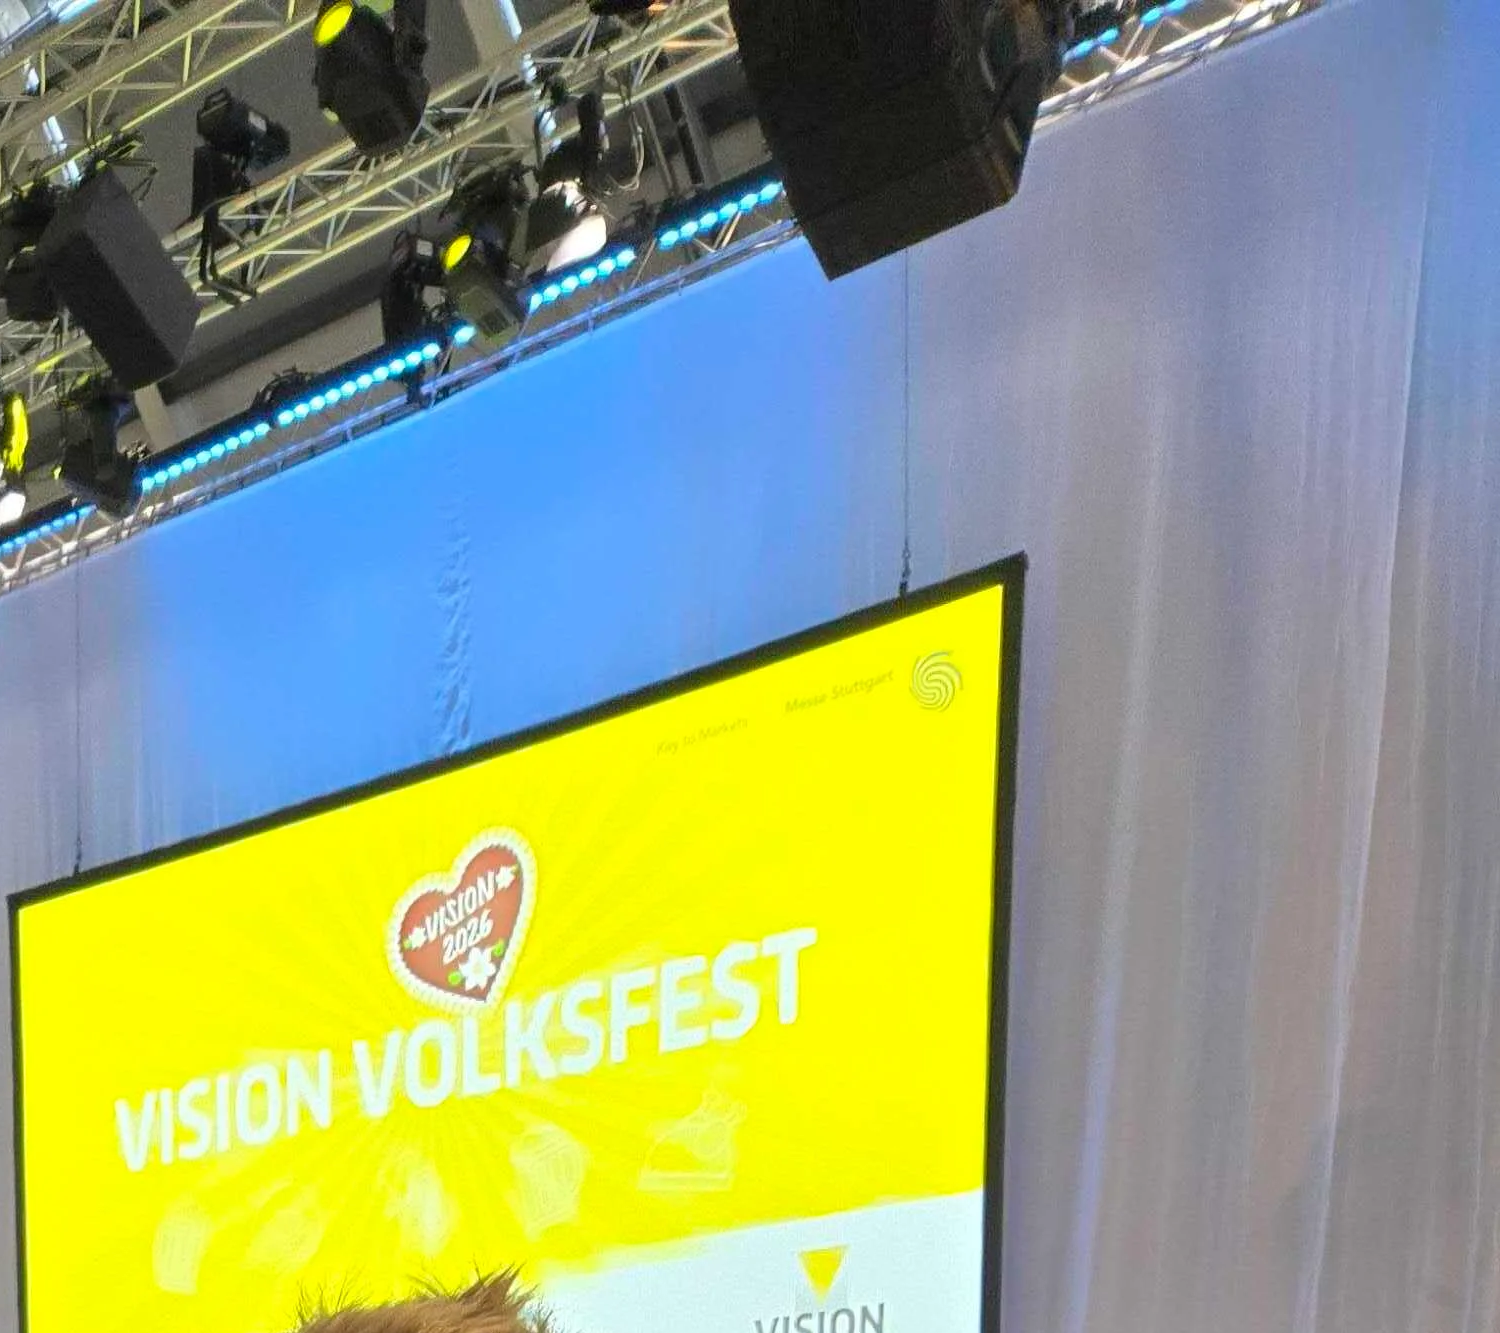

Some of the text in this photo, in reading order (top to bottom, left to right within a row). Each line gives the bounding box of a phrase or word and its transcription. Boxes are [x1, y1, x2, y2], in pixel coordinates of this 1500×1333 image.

[424, 870, 497, 943] VISION
[442, 908, 494, 966] 2026
[114, 927, 818, 1173] VISION VOLKSFEST
